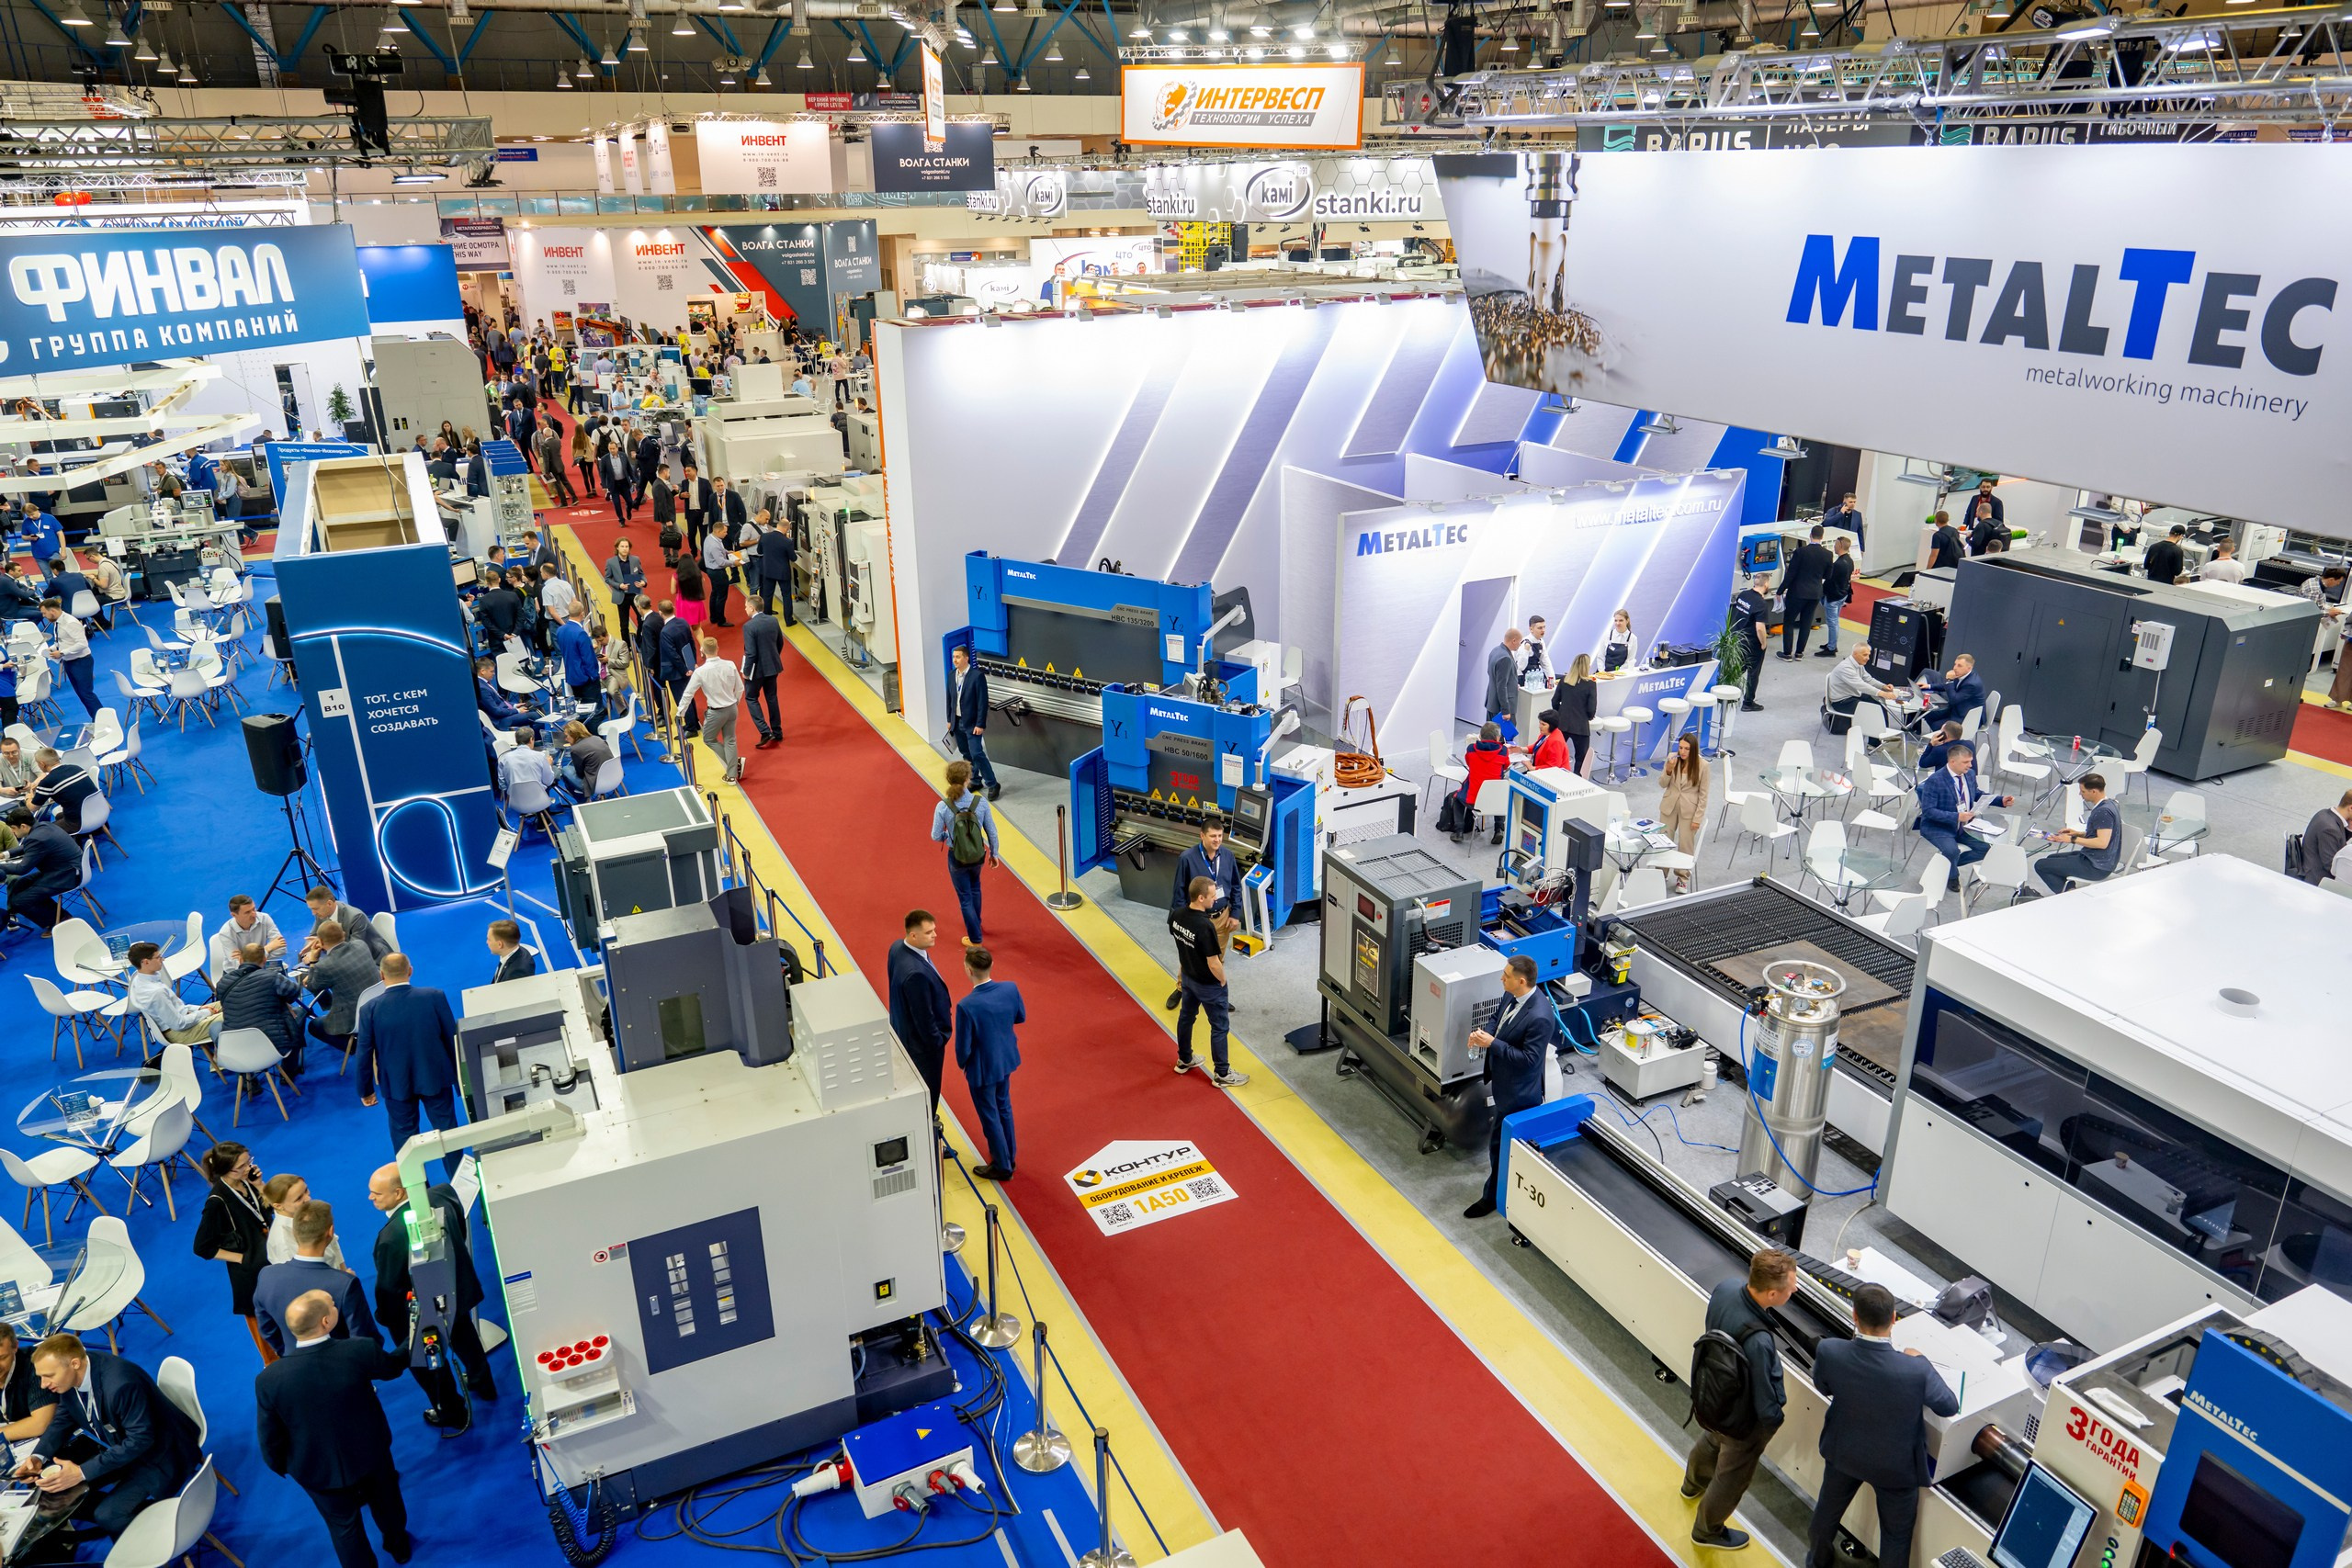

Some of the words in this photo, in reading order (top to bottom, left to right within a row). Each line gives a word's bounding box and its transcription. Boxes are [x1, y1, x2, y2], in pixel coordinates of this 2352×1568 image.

[1195, 87, 1326, 110] ИНТЕРВЕСП
[1194, 113, 1261, 124] ТЕХНОЛОГИИ
[1268, 114, 1310, 125] УСПЕХА
[741, 135, 786, 146] ИНВЕНТ
[899, 158, 932, 167] ВОЛГА
[933, 158, 970, 167] СТАНКИ
[966, 193, 996, 209] stanki.ru
[1147, 193, 1195, 215] stanki.ru
[1316, 190, 1420, 215] stanki.ru
[469, 242, 500, 250] ОСМОТРА
[544, 246, 583, 258] ИНВЕНТ
[636, 243, 685, 256] ИНВЕНТ
[742, 241, 775, 250] ВОЛГА
[776, 240, 814, 249] СТАНКИ
[834, 258, 852, 268] ВОЛГА
[853, 256, 873, 266] СТАНКИ
[1115, 250, 1133, 259] ЦТО
[9, 243, 295, 322] ФИНВАЛ
[1785, 233, 2339, 377] METALTEC
[28, 328, 149, 360] ГРУППА
[159, 309, 299, 345] КОМПАНИЙ
[2026, 366, 2173, 404] metalworking
[2180, 382, 2309, 422] machinery
[1356, 523, 1468, 557] METALTEC
[1007, 568, 1036, 581] METALTEC
[1112, 615, 1125, 623] HBC
[1126, 615, 1155, 626] 135/3200
[1637, 677, 1686, 694] METALTEC
[364, 694, 390, 705] ТОТ,
[393, 693, 401, 701] С
[403, 689, 428, 700] КЕМ
[324, 704, 345, 712] B10
[368, 705, 419, 720] ХОЧЕТСЯ
[1149, 707, 1189, 722] METALTEC
[370, 716, 439, 734] СОЗДАВАТЬ
[1164, 746, 1180, 755] HBC
[1182, 748, 1208, 761] 50/1600
[1170, 771, 1179, 787] 3
[1103, 1146, 1192, 1177] КОНТУР
[1090, 1178, 1160, 1203] ОБОРУДОВАНИЕ
[1168, 1165, 1205, 1180] КРЕПЕЖ
[1516, 1172, 1545, 1209] T-30
[1133, 1187, 1190, 1214] 1A50
[2188, 1390, 2259, 1442] METALTEC
[2065, 1406, 2089, 1441] 3
[2088, 1418, 2140, 1470] ГОДА
[2086, 1439, 2137, 1482] ГАРАНТИИ
